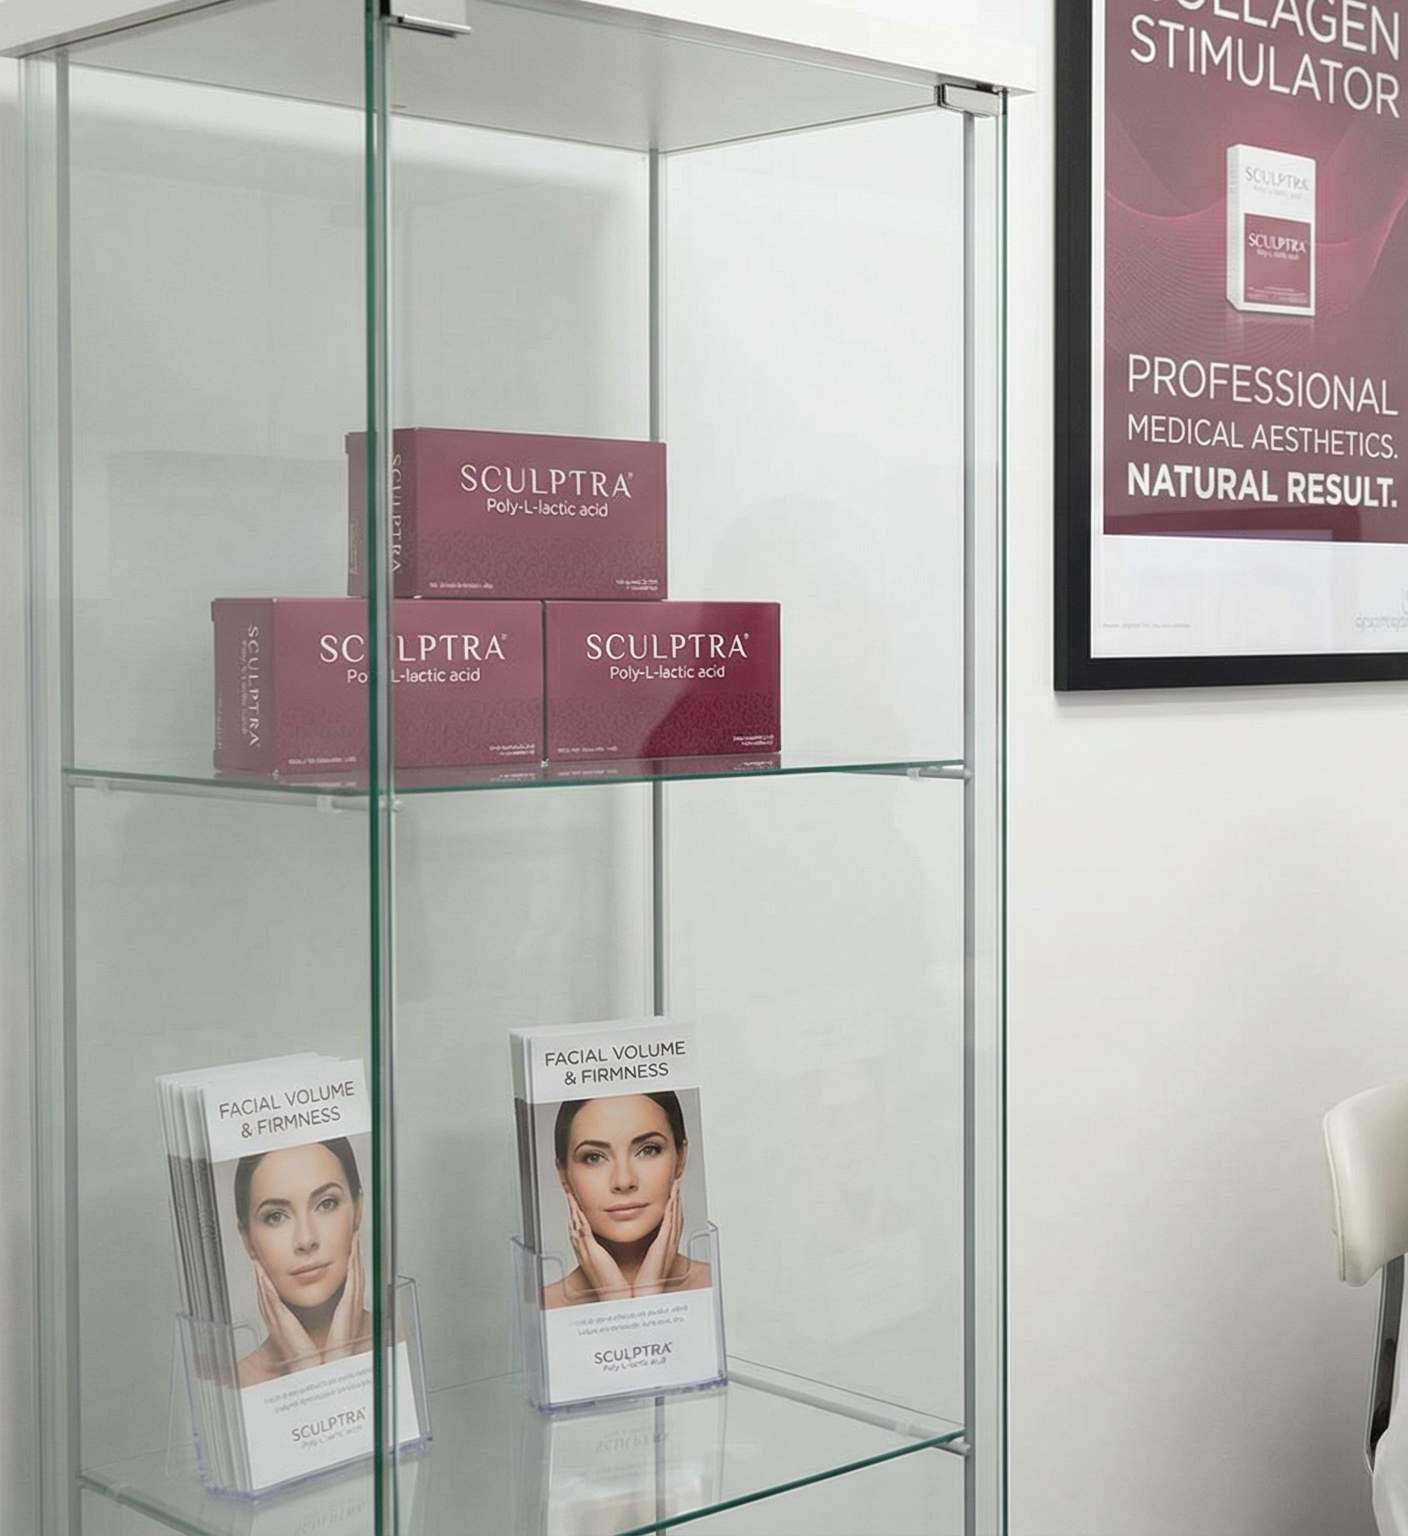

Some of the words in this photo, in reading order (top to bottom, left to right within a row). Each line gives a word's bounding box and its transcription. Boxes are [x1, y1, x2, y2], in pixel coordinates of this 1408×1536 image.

[1151, 0, 1399, 61] LLAGEN
[1131, 14, 1400, 118] STIMULATOR
[1128, 354, 1399, 416] PROFESSIONAL
[1128, 414, 1243, 448] MEDICAL
[1251, 424, 1399, 459] AESTHETICS.
[1128, 462, 1278, 502] NATURAL
[1288, 472, 1398, 508] RESULT.
[487, 498, 576, 516] Poly-L-lactic
[579, 503, 608, 517] acid
[449, 667, 481, 682] acid
[610, 665, 695, 682] Poly-L-lactic
[698, 664, 725, 678] acid
[545, 1048, 608, 1067] FACIAL
[612, 1041, 686, 1060] VOLUME
[564, 1071, 577, 1085] &
[581, 1062, 669, 1084] FIRMNESS
[219, 1095, 281, 1120] FACIAL
[284, 1081, 355, 1106] VOLUME
[241, 1122, 253, 1138] &
[257, 1106, 341, 1135] FIRMNESS
